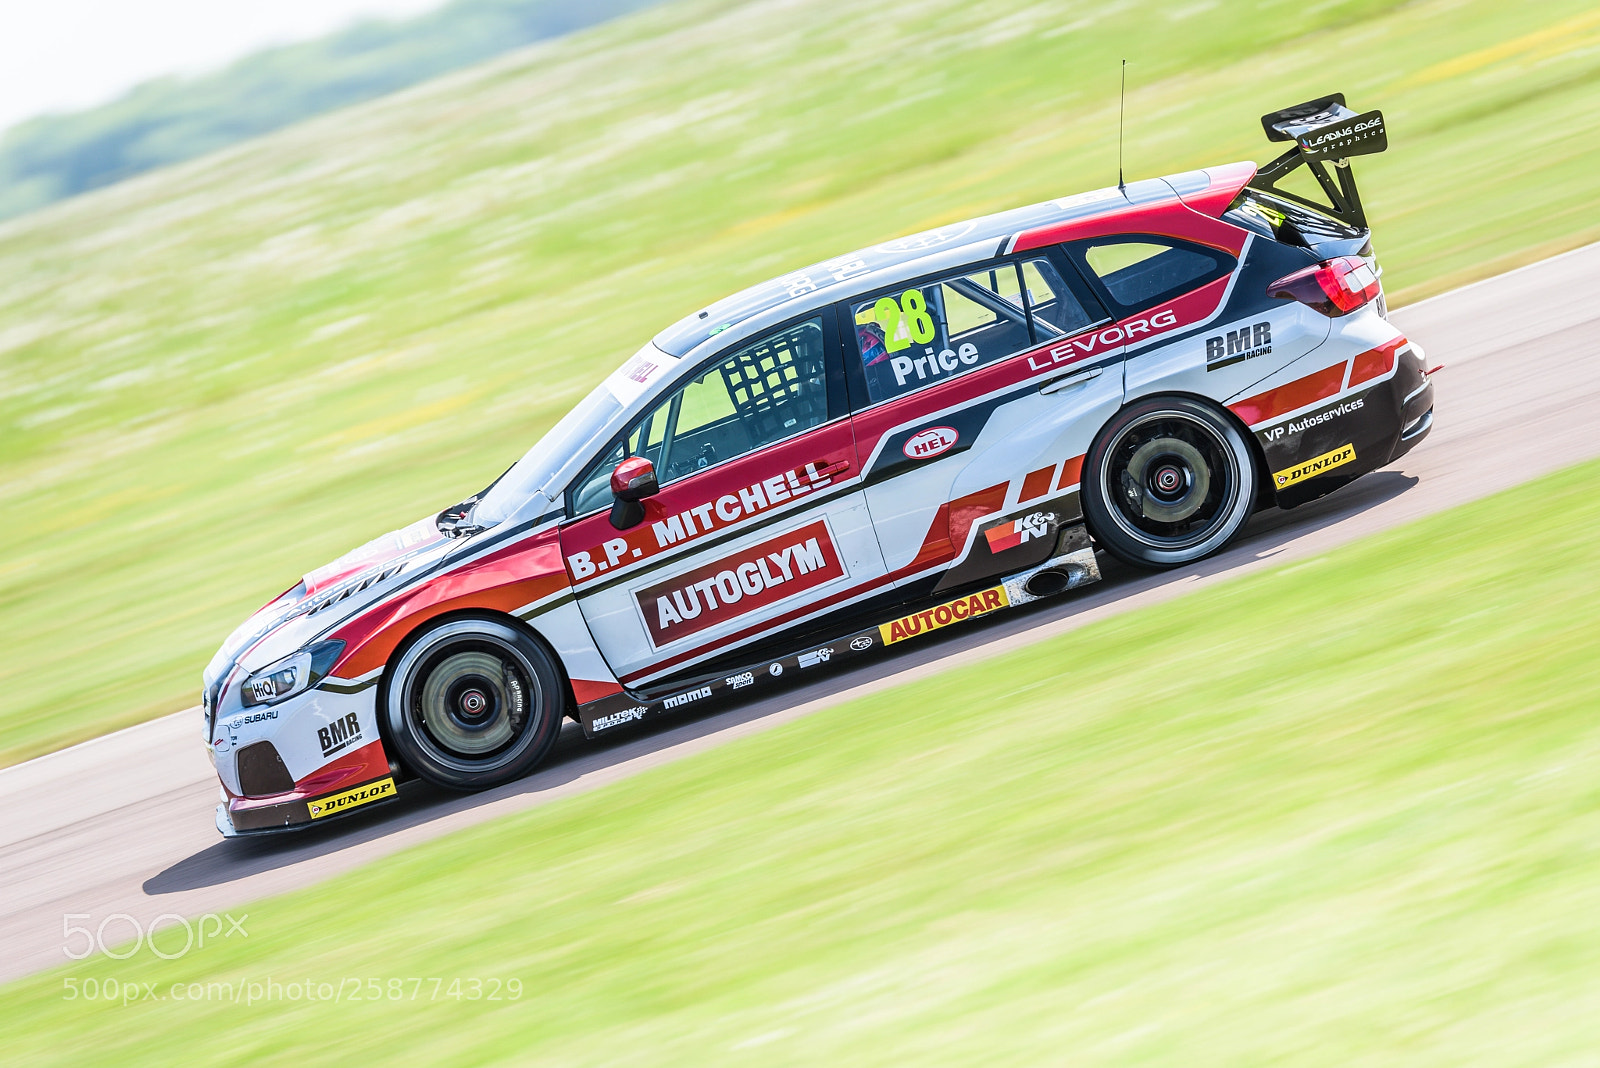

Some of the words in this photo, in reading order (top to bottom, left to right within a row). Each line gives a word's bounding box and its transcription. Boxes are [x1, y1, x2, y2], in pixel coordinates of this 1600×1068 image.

[1309, 127, 1352, 147] LEADING
[1355, 117, 1381, 132] EDGE
[1322, 128, 1384, 152] graphics
[874, 289, 935, 355] 28
[1027, 309, 1177, 371] LEVORG
[1206, 321, 1272, 362] BMR
[1246, 345, 1272, 361] RACING
[889, 342, 979, 386] Price
[1264, 424, 1285, 442] VP
[1288, 398, 1365, 435] Autoservices
[913, 434, 952, 456] HEL
[1290, 449, 1352, 480] DUNLOP
[567, 537, 643, 581] B.P.
[651, 463, 832, 548] MITCHELL
[1014, 511, 1055, 544] K&N
[656, 537, 827, 630] AUTOGLYM
[890, 589, 1002, 642] AUTOCAR
[725, 671, 753, 686] SAMCO
[244, 711, 279, 724] SUBARU
[317, 712, 361, 752] BMR
[346, 733, 363, 747] RACING
[325, 783, 391, 811] DUNLOP
